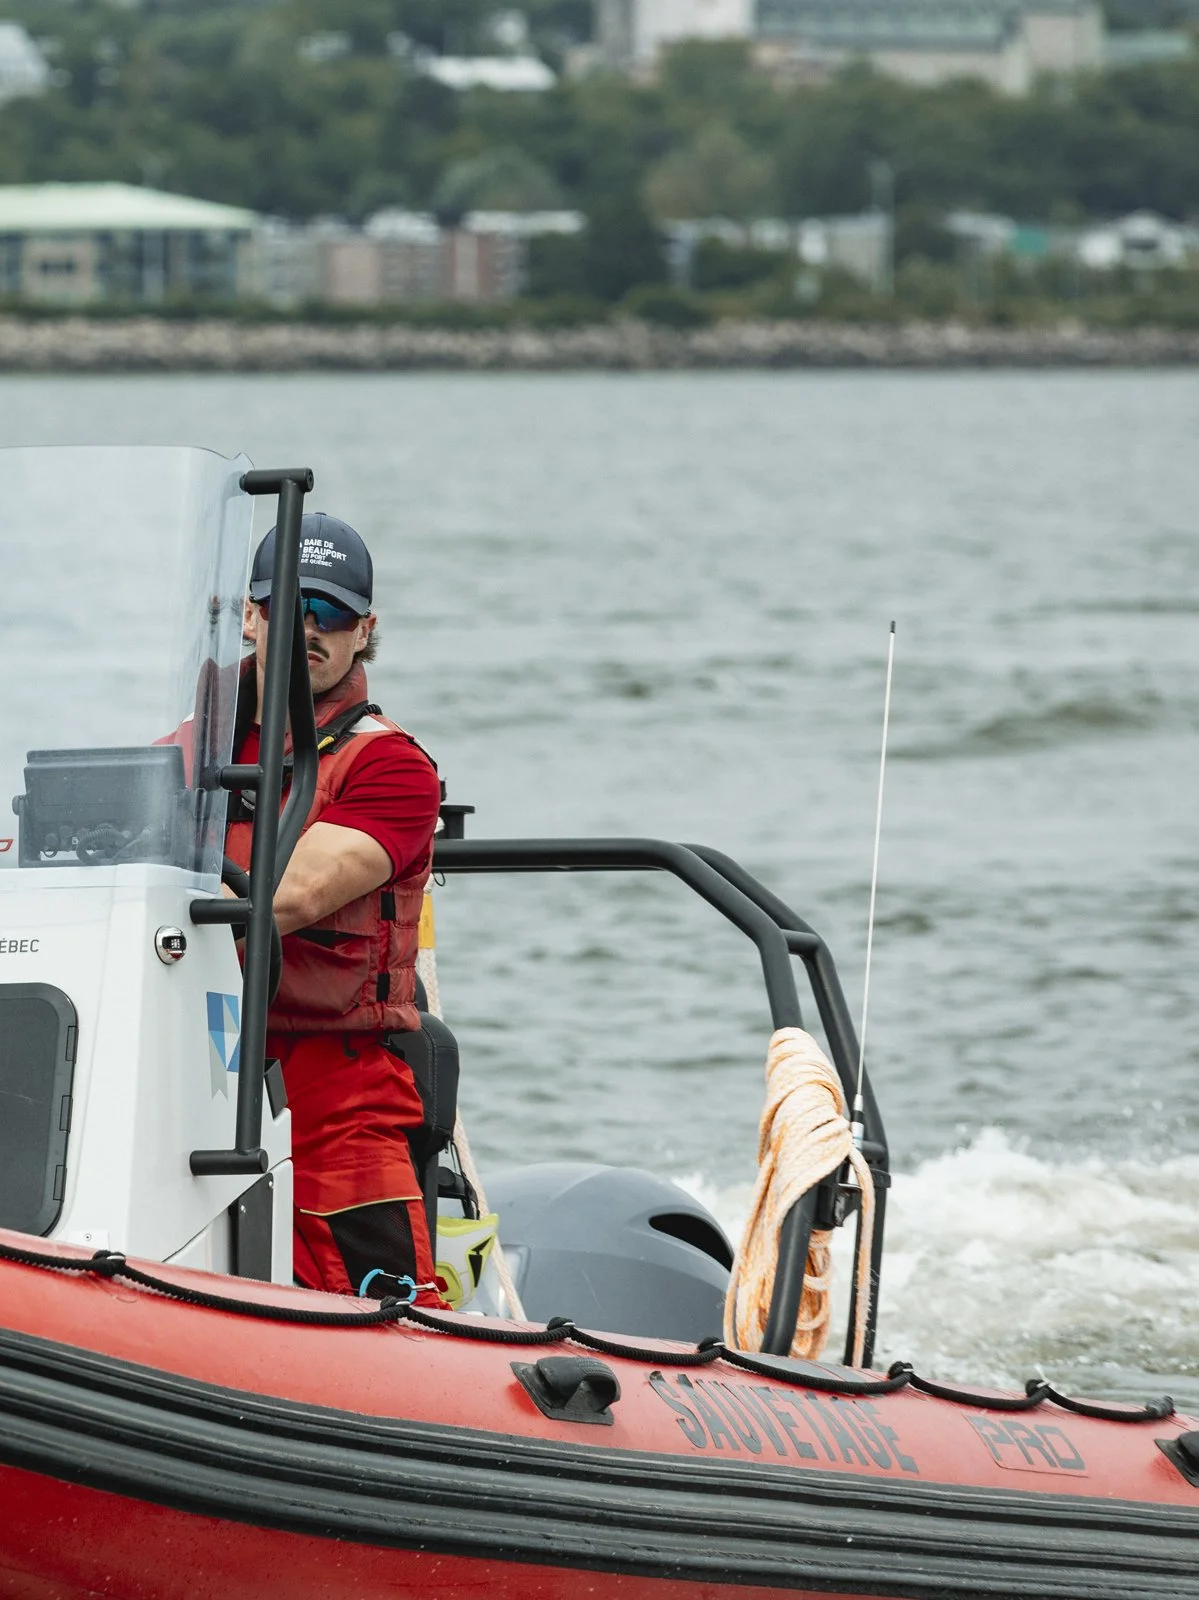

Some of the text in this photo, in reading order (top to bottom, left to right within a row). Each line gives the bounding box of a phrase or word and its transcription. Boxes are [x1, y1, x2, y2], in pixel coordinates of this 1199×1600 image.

[304, 538, 334, 550] BAIE DE
[302, 546, 348, 561] BEAUPORT
[310, 553, 327, 561] PORT
[648, 1370, 1086, 1475] SAUVETAGE PRO
